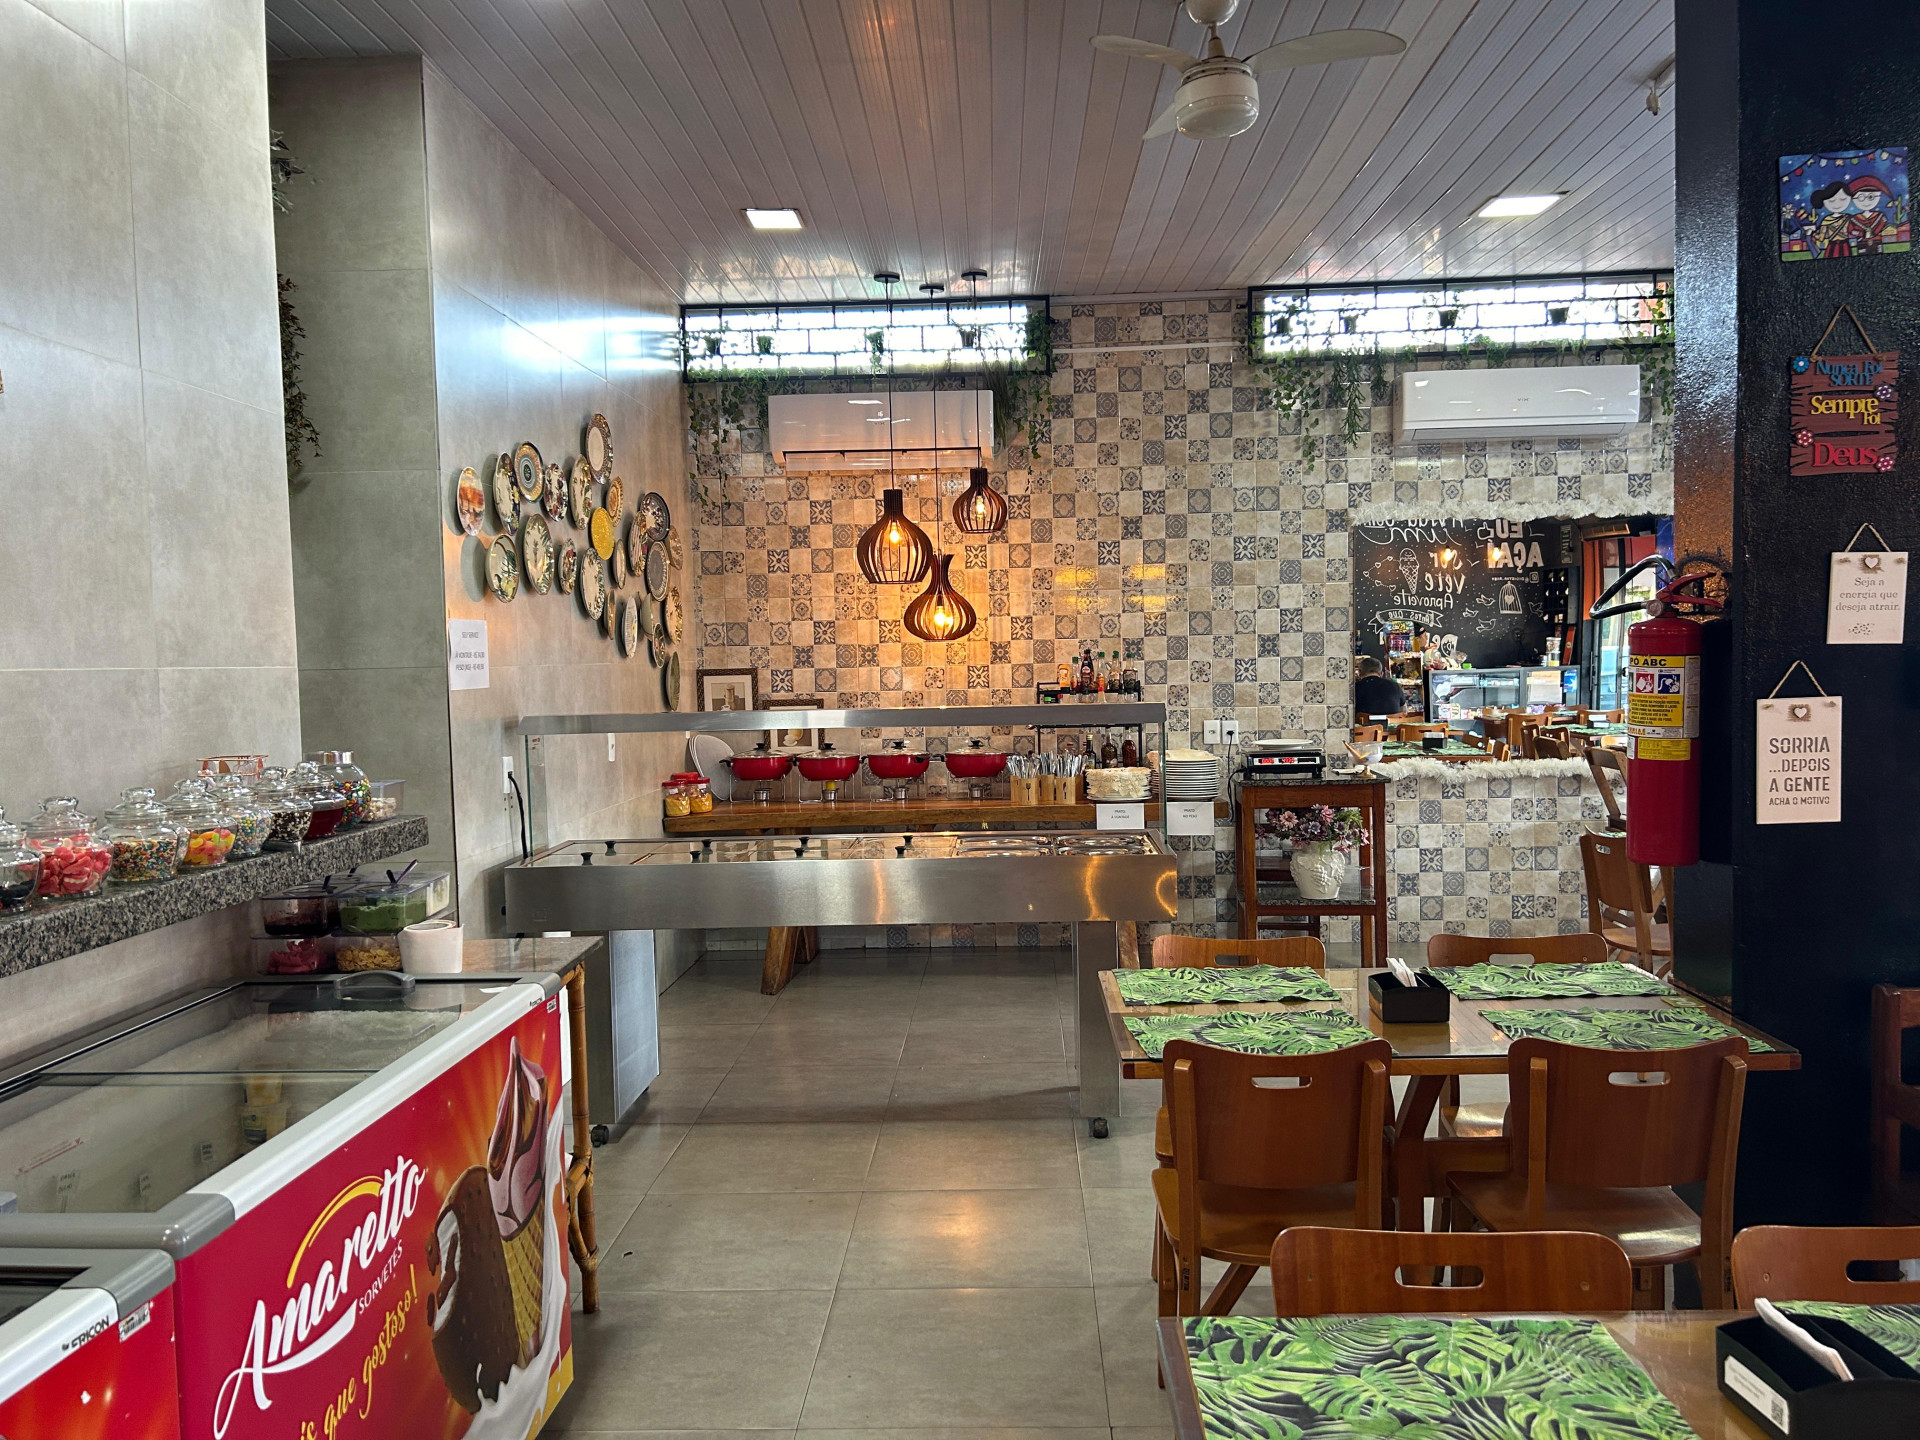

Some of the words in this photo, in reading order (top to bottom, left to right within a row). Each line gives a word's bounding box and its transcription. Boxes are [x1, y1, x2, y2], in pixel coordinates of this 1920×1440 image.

[1815, 360, 1859, 375] Nunca
[1810, 395, 1879, 419] Sempre
[1863, 412, 1881, 425] Foi
[1812, 442, 1878, 467] Deus
[1854, 577, 1876, 588] Seja
[1839, 590, 1877, 600] energia
[1879, 592, 1898, 600] que
[1835, 602, 1866, 613] deseja
[1642, 658, 1667, 667] ABC
[1769, 736, 1830, 754] SORRIA
[1769, 758, 1830, 773] ...DEPOIS
[1769, 778, 1779, 792] A
[1784, 776, 1830, 792] GENTE
[1769, 797, 1790, 806] ACHA
[1792, 796, 1798, 805] O
[1800, 796, 1830, 805] MOTIVO
[358, 1239, 404, 1315] SORVETES
[213, 1155, 426, 1440] Amaretto
[358, 1263, 418, 1420] gostoso!
